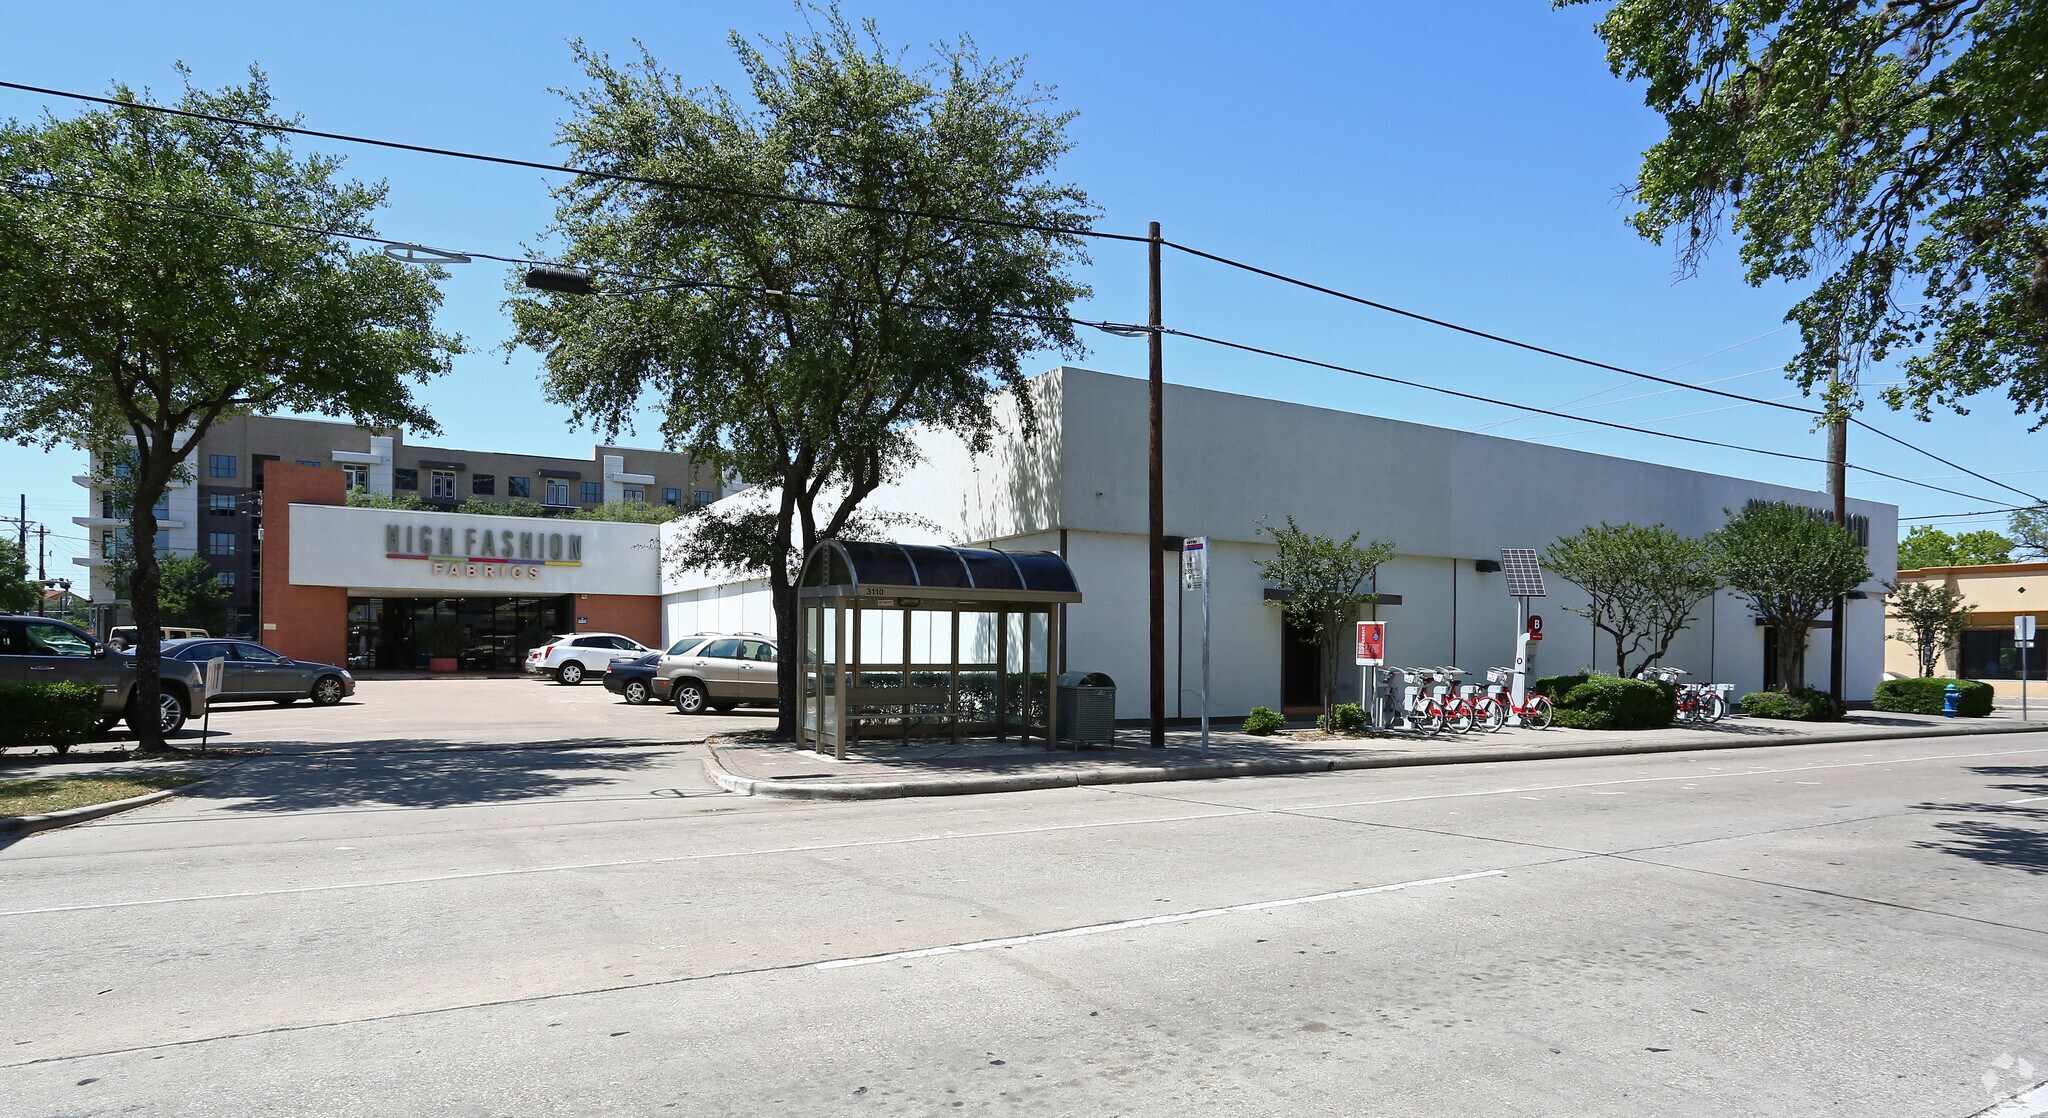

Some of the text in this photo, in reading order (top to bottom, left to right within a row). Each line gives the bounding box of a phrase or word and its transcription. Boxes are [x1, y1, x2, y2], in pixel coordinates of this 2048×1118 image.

[386, 525, 582, 561] HIGH FASHION
[433, 563, 539, 580] FABRICS
[866, 588, 884, 596] 3110
[1534, 619, 1540, 629] B
